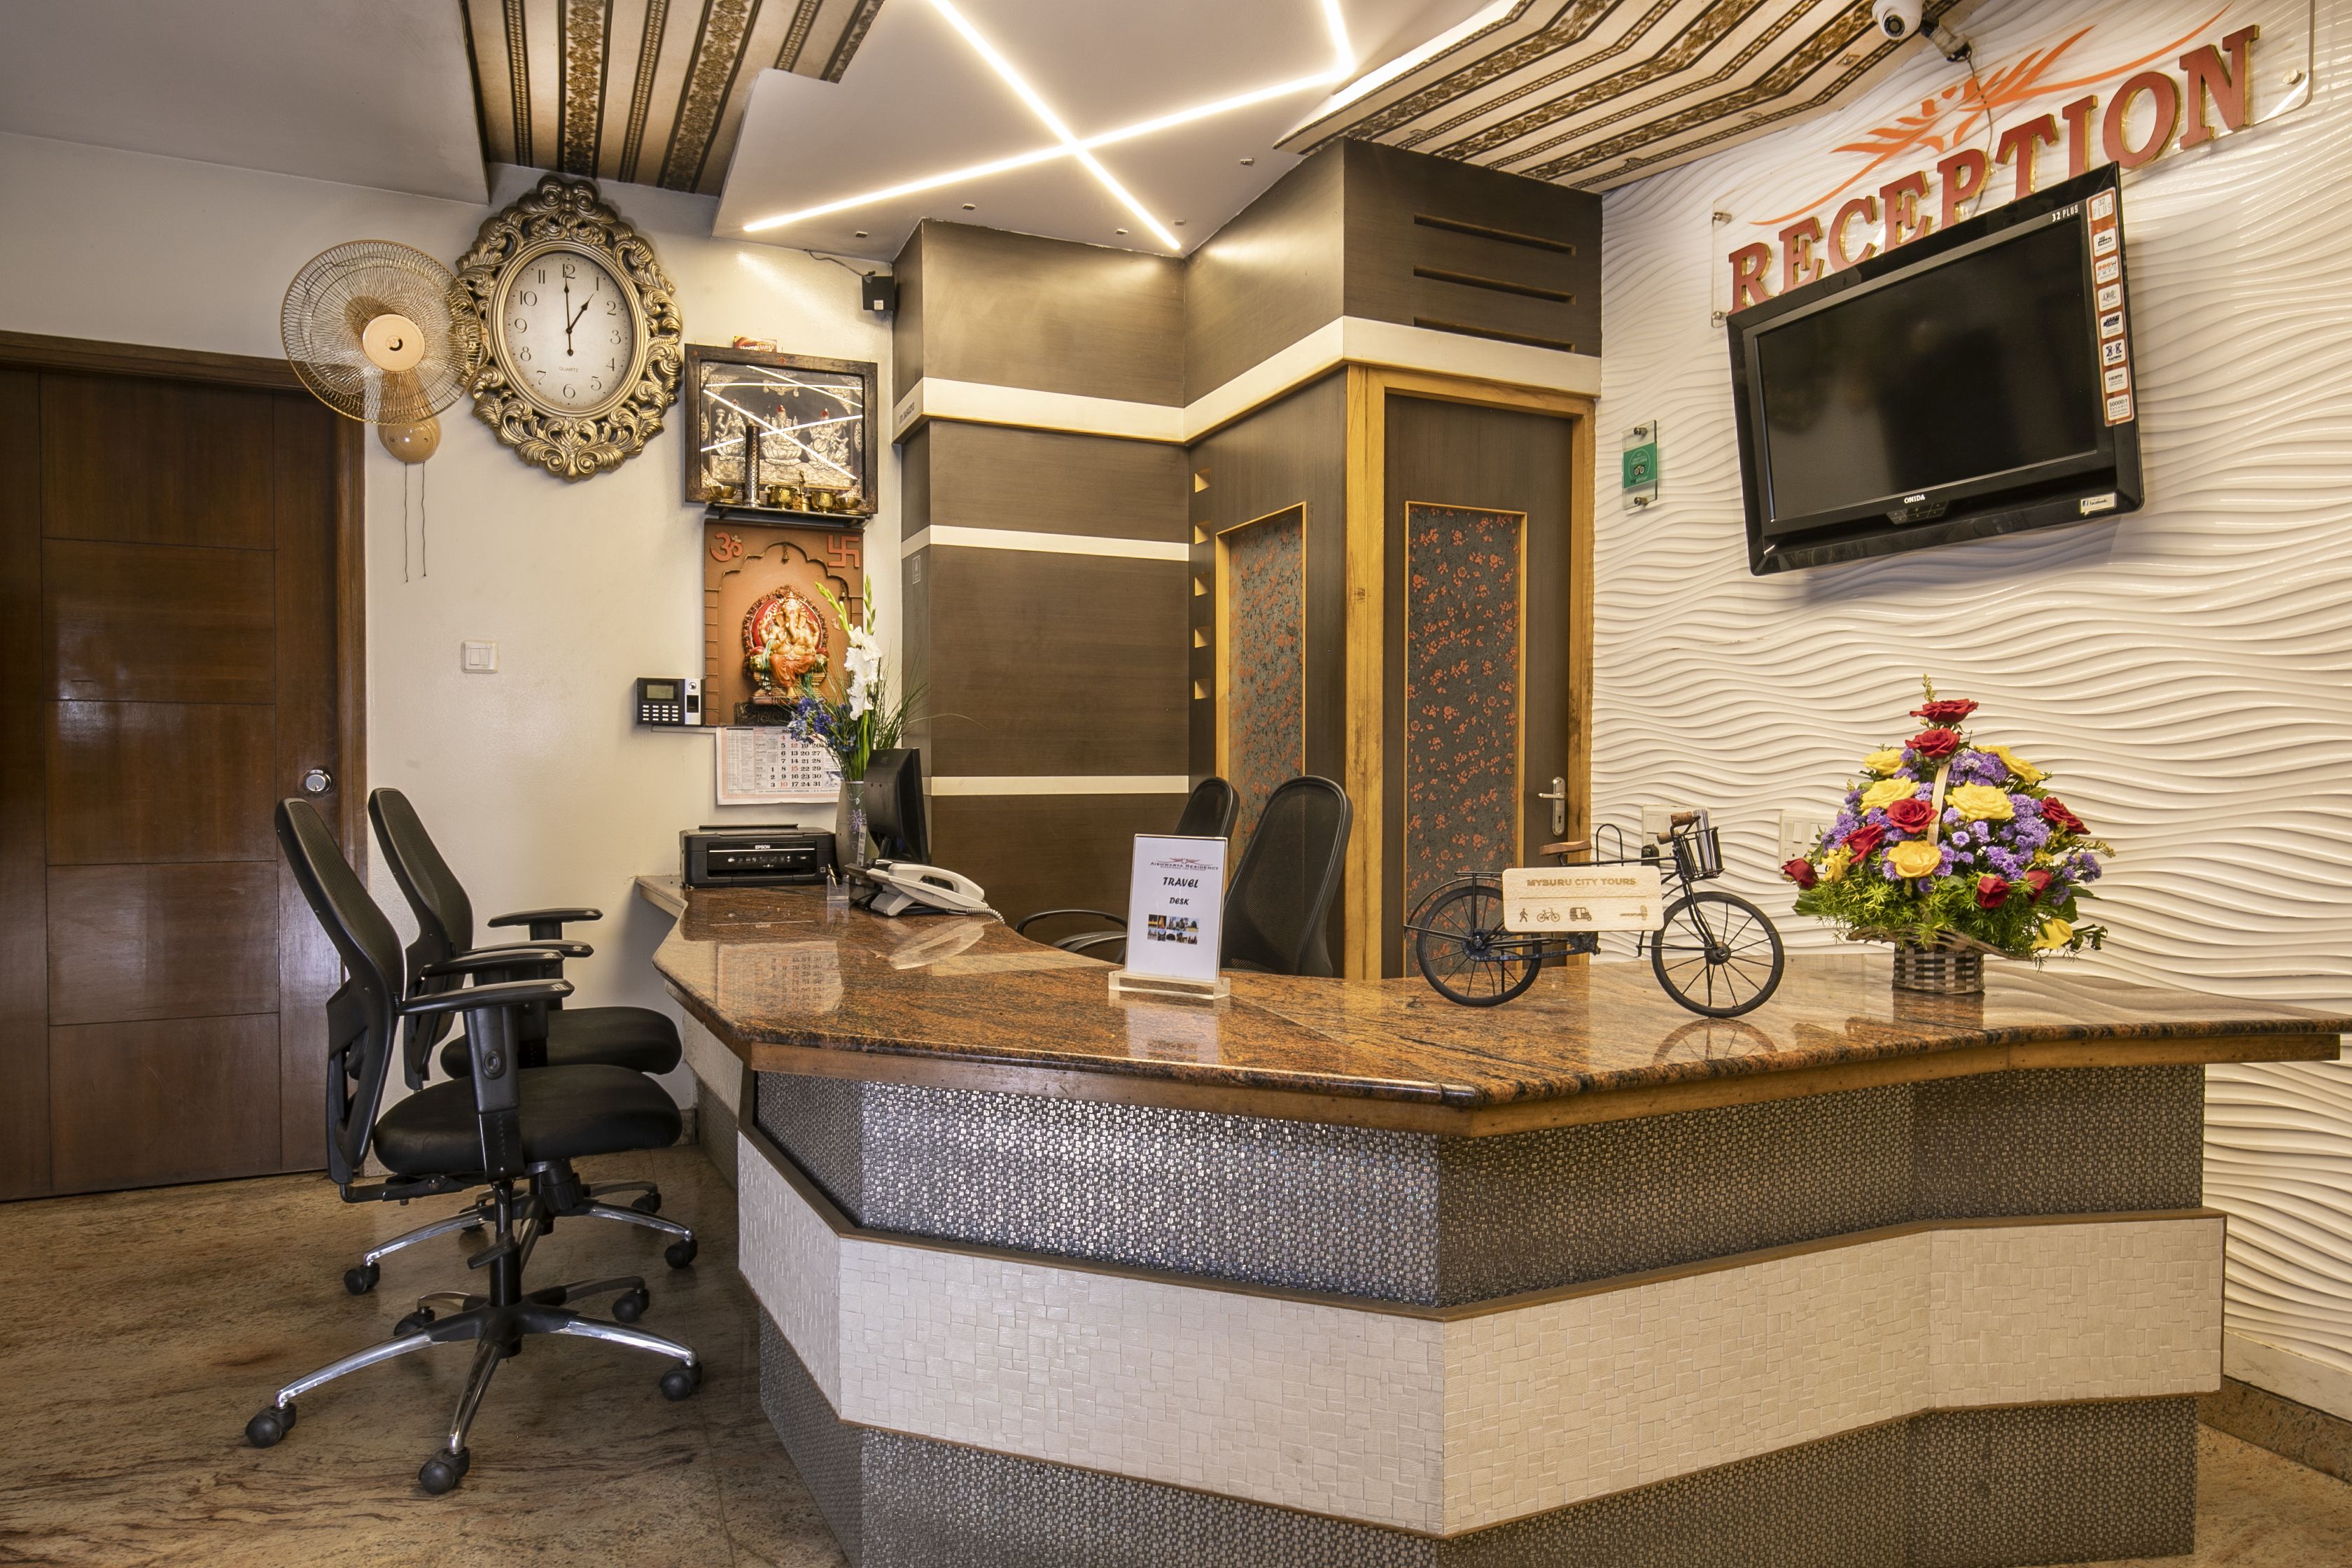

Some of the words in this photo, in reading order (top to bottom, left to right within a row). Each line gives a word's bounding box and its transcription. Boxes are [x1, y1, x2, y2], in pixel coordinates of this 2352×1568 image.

[1728, 24, 2260, 315] RECEPTION
[2098, 197, 2106, 206] 32
[2052, 211, 2061, 222] 32
[2062, 204, 2078, 218] PLUS
[2093, 202, 2112, 218] PLUS
[538, 270, 545, 284] 11
[563, 263, 575, 279] 12
[520, 290, 538, 307] 10
[606, 300, 617, 316] 2
[514, 318, 527, 333] 9
[610, 330, 621, 345] 3
[520, 346, 531, 362] 8
[606, 357, 615, 372] 4
[536, 370, 547, 385] 7
[591, 376, 602, 391] 5
[563, 384, 576, 399] 6
[1904, 494, 1926, 504] ONIDA
[1163, 876, 1199, 888] TRAVEL
[1169, 897, 1189, 905] DESK
